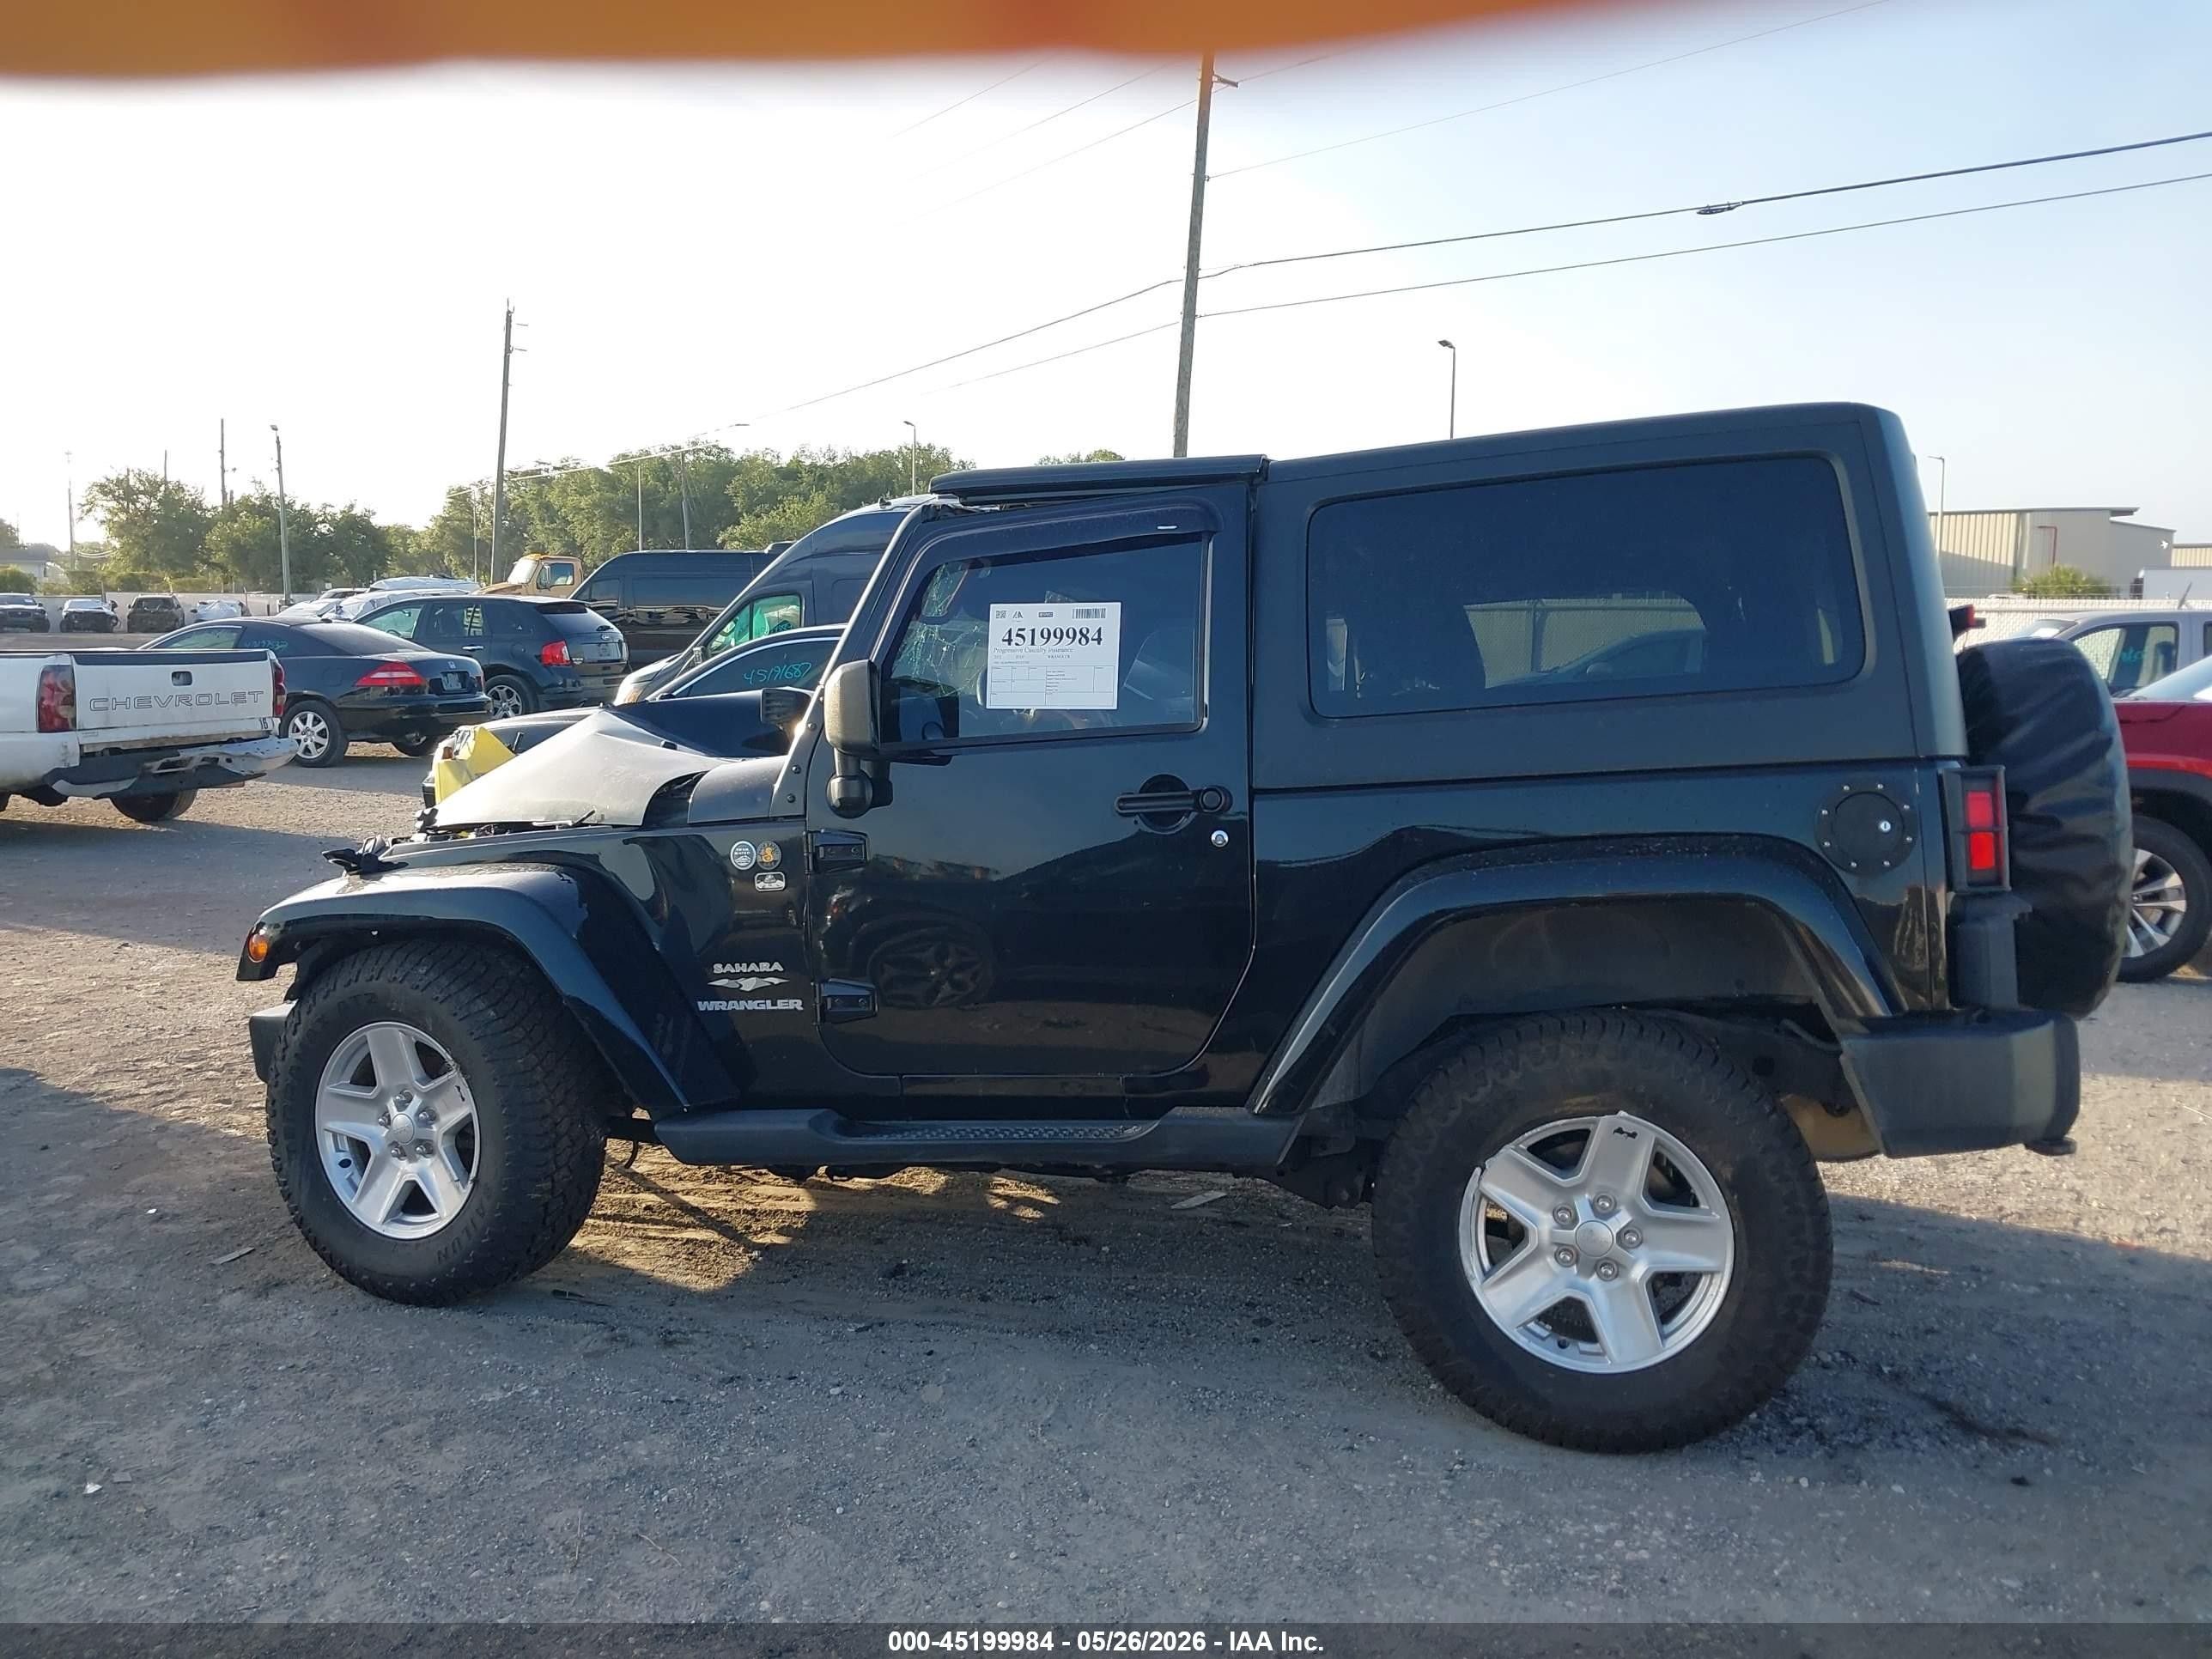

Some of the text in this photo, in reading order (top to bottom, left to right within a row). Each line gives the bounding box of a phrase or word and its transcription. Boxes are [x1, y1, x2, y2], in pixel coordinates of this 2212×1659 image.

[1002, 627, 1103, 646] 45199984
[744, 662, 811, 684] 45191687
[89, 690, 264, 712] CHEVROLET
[713, 962, 784, 974] SAHARA
[696, 999, 804, 1011] WRANGLER
